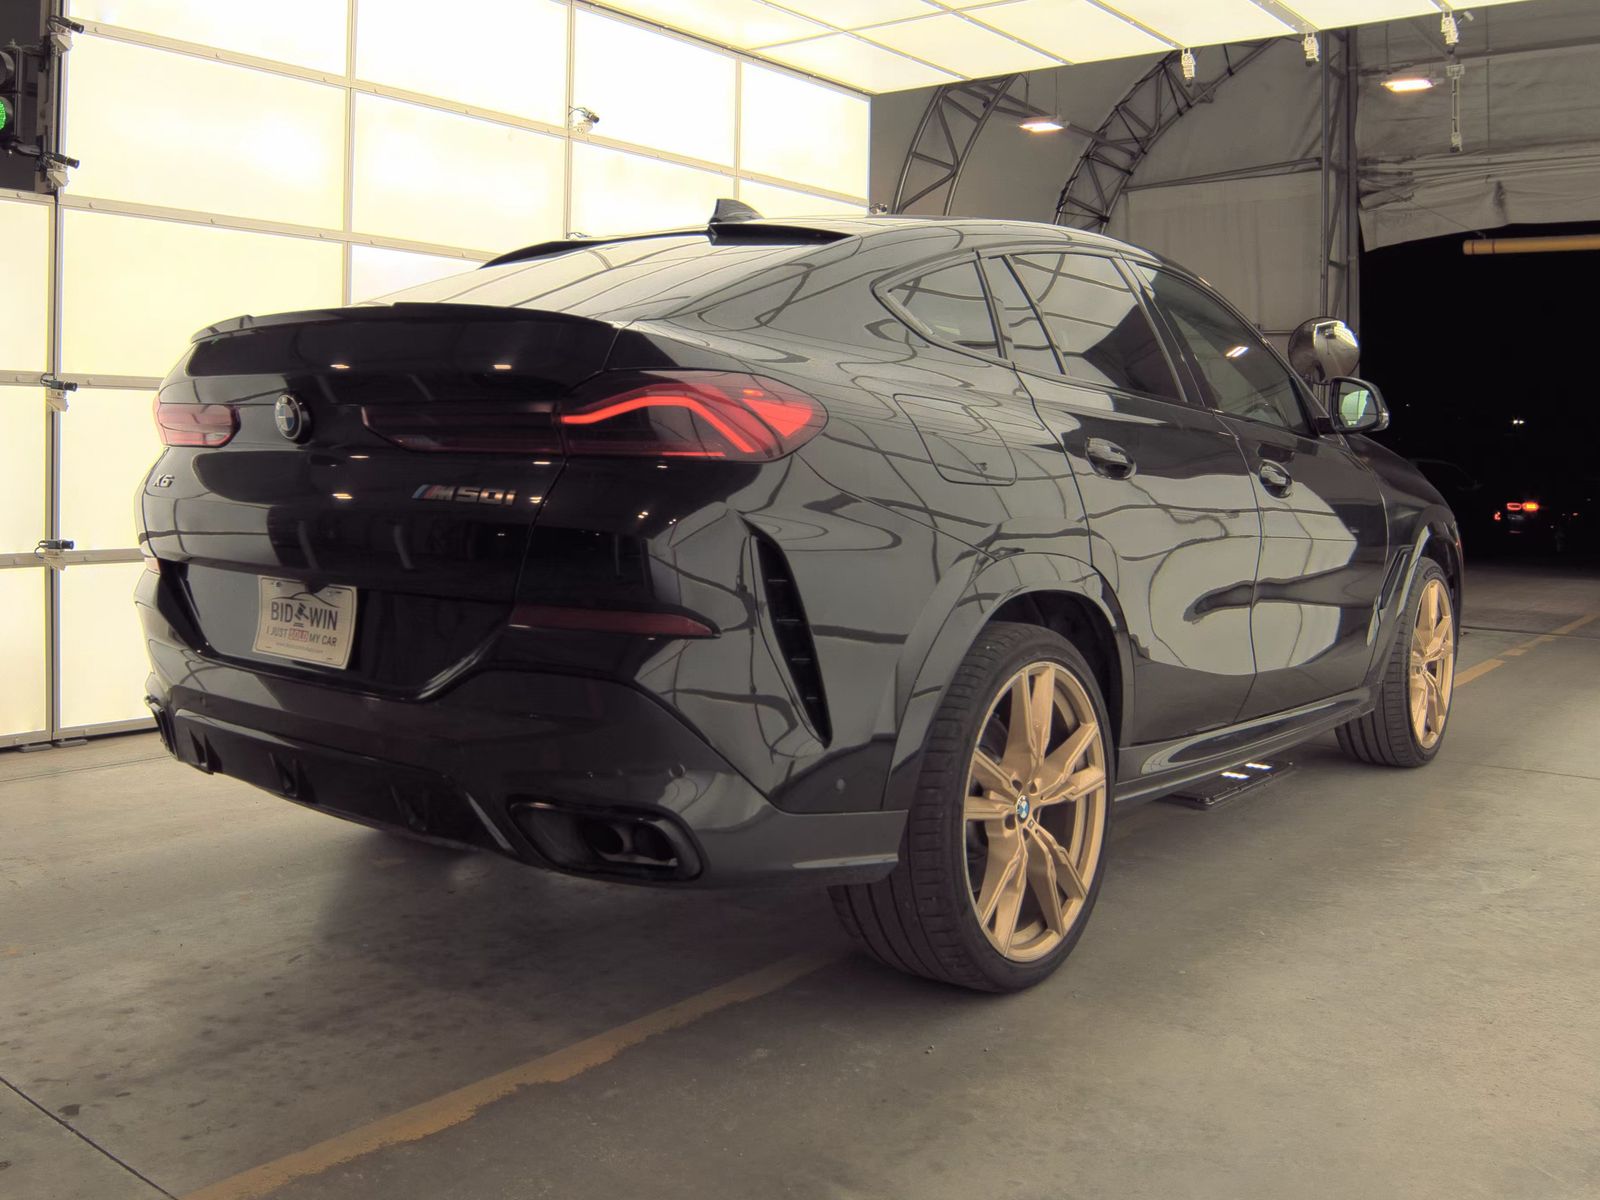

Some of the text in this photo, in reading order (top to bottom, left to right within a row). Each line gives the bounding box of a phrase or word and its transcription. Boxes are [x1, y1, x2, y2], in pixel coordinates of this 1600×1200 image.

[154, 473, 175, 488] X6
[421, 484, 516, 506] M50i
[271, 601, 338, 631] BID WIN
[271, 627, 288, 638] JUST
[309, 632, 320, 644] MY
[322, 635, 337, 648] CAR
